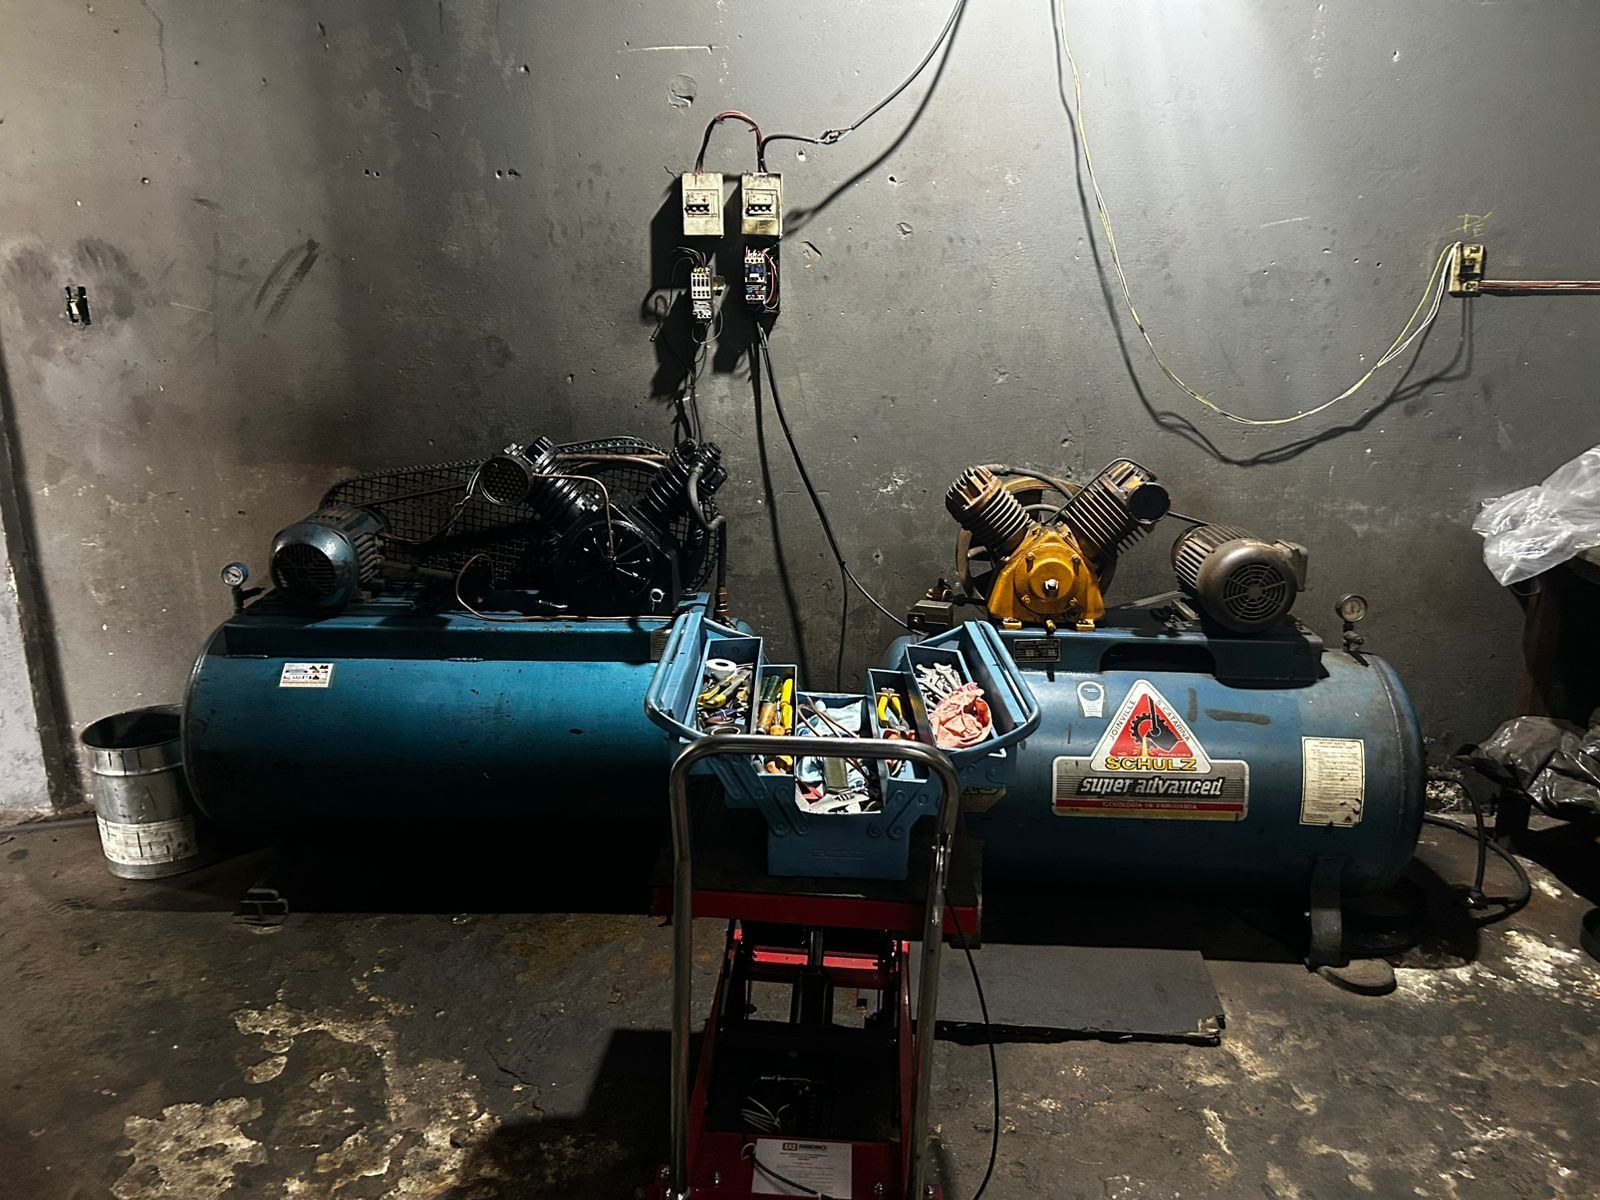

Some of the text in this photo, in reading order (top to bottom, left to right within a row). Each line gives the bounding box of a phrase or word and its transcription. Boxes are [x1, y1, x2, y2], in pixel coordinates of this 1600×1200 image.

[1109, 699, 1137, 741] JOINVILLE
[1162, 706, 1191, 742] CATARINA
[1105, 757, 1197, 771] SCHULZ
[1081, 776, 1223, 795] super advanced
